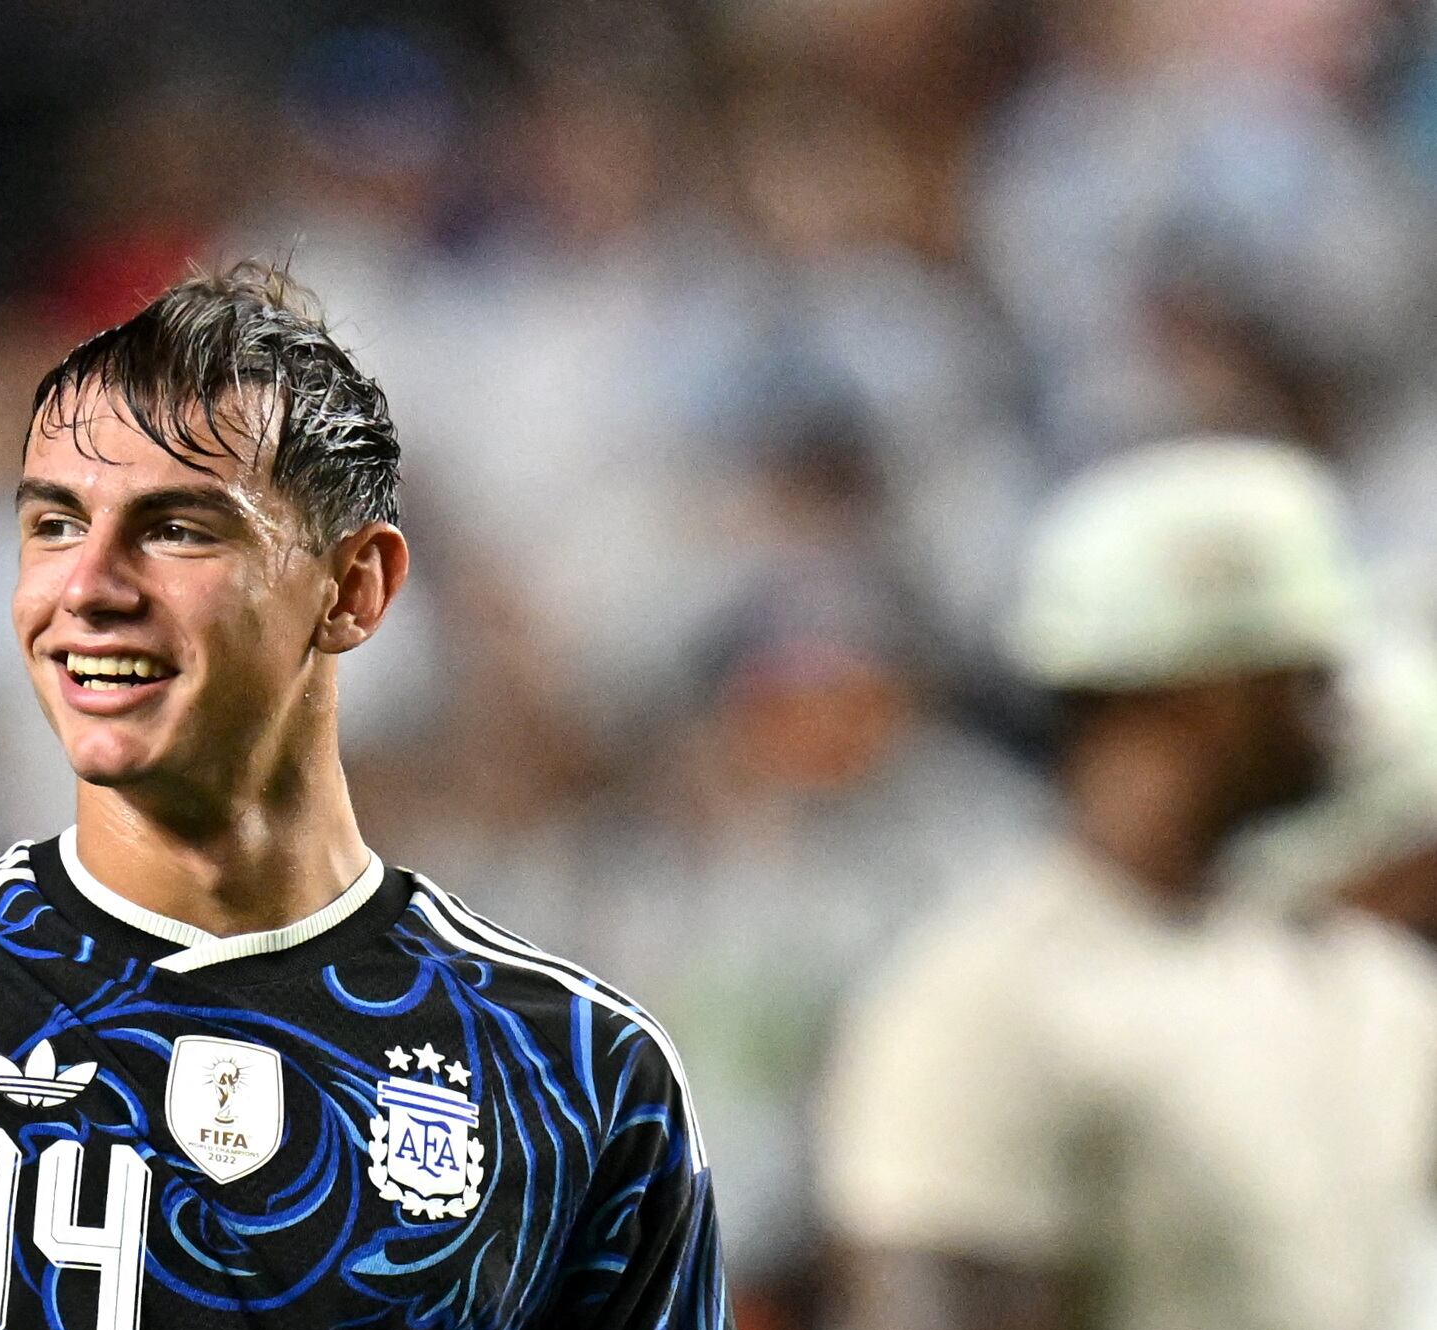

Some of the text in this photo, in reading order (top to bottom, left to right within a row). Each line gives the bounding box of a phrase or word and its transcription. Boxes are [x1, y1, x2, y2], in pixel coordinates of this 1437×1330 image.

[200, 1128, 248, 1149] FIFA
[395, 1112, 460, 1178] AFA
[208, 1152, 236, 1165] 2022
